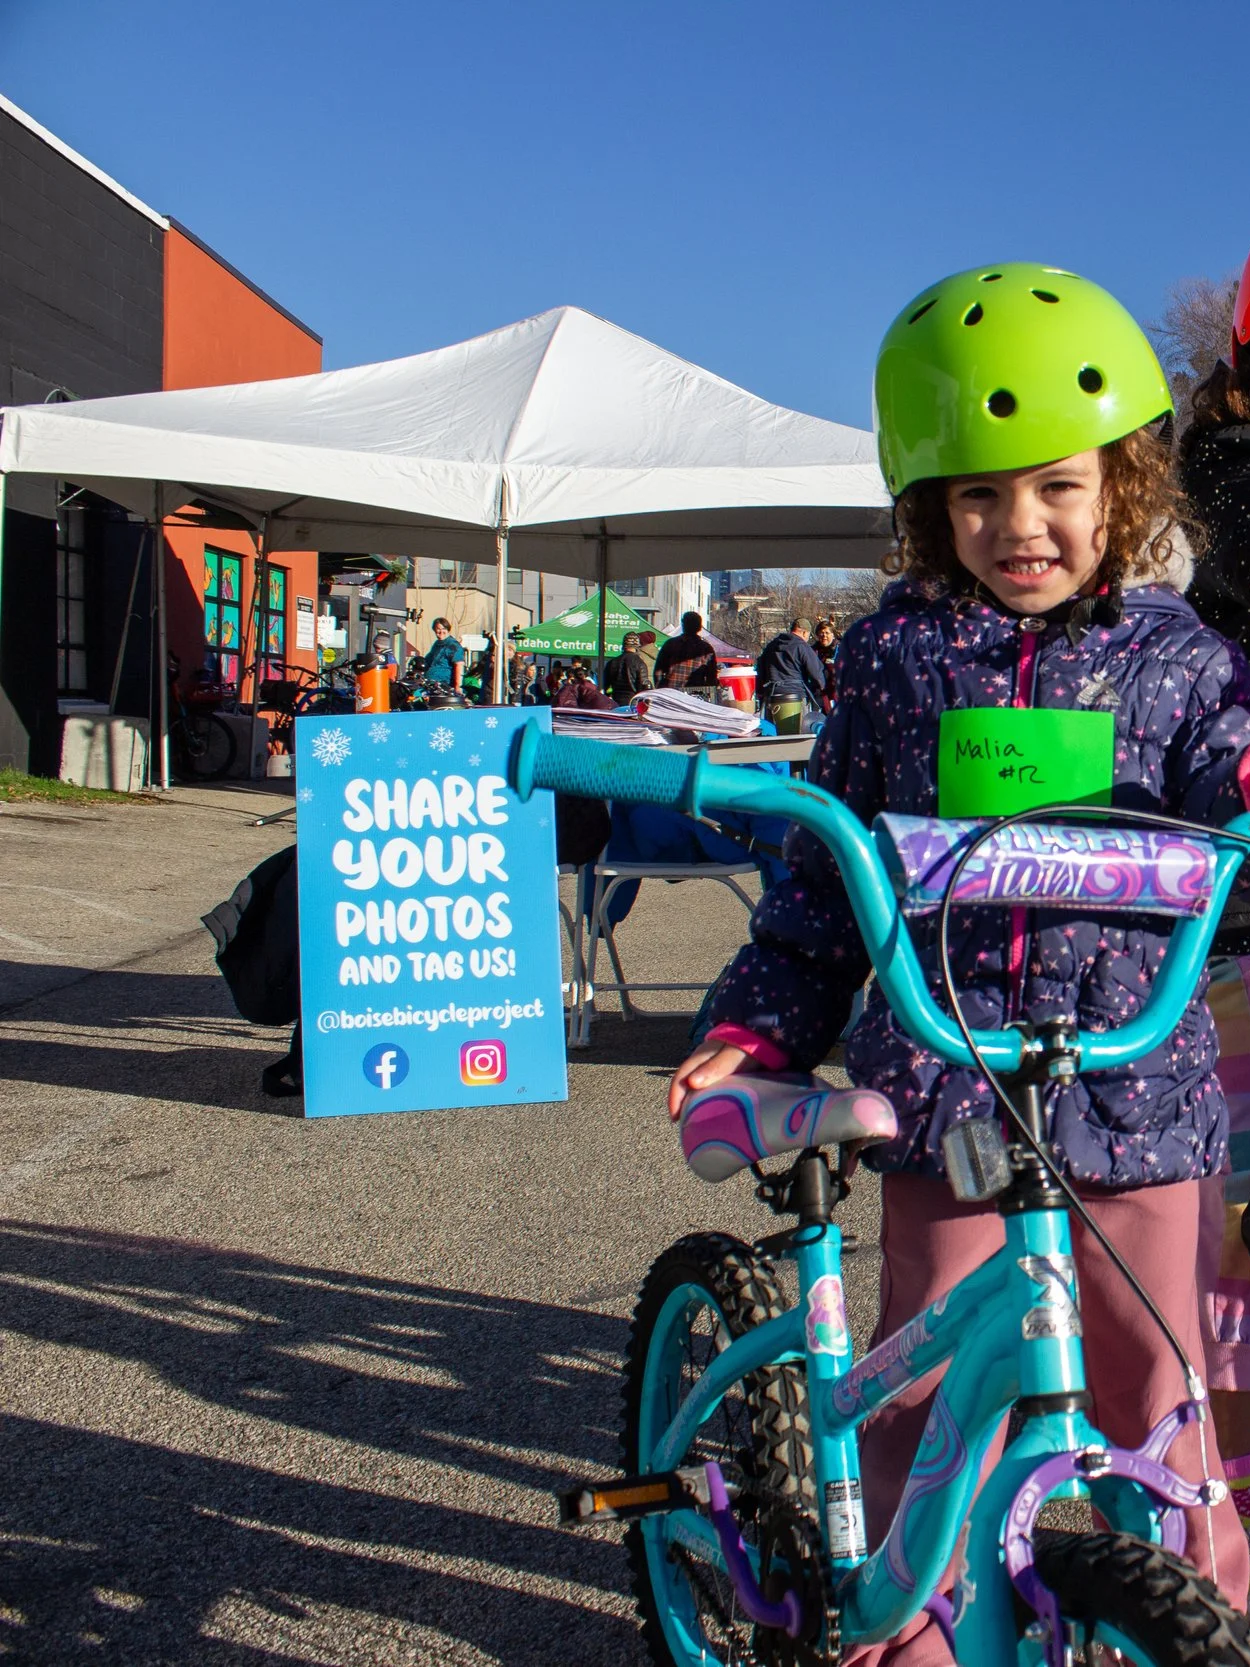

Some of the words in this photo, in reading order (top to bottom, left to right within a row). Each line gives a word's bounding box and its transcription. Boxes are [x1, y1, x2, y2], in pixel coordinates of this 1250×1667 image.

[519, 637, 550, 649] Idaho
[553, 639, 596, 651] Central
[956, 738, 1024, 764] Malia
[343, 775, 508, 832] SHARE
[333, 833, 509, 890] YOUR
[336, 892, 512, 946] PHOTOS
[339, 955, 401, 986] AND
[407, 951, 464, 982] TAG
[469, 947, 516, 979] US!
[317, 998, 544, 1033] @boisebicycleproject
